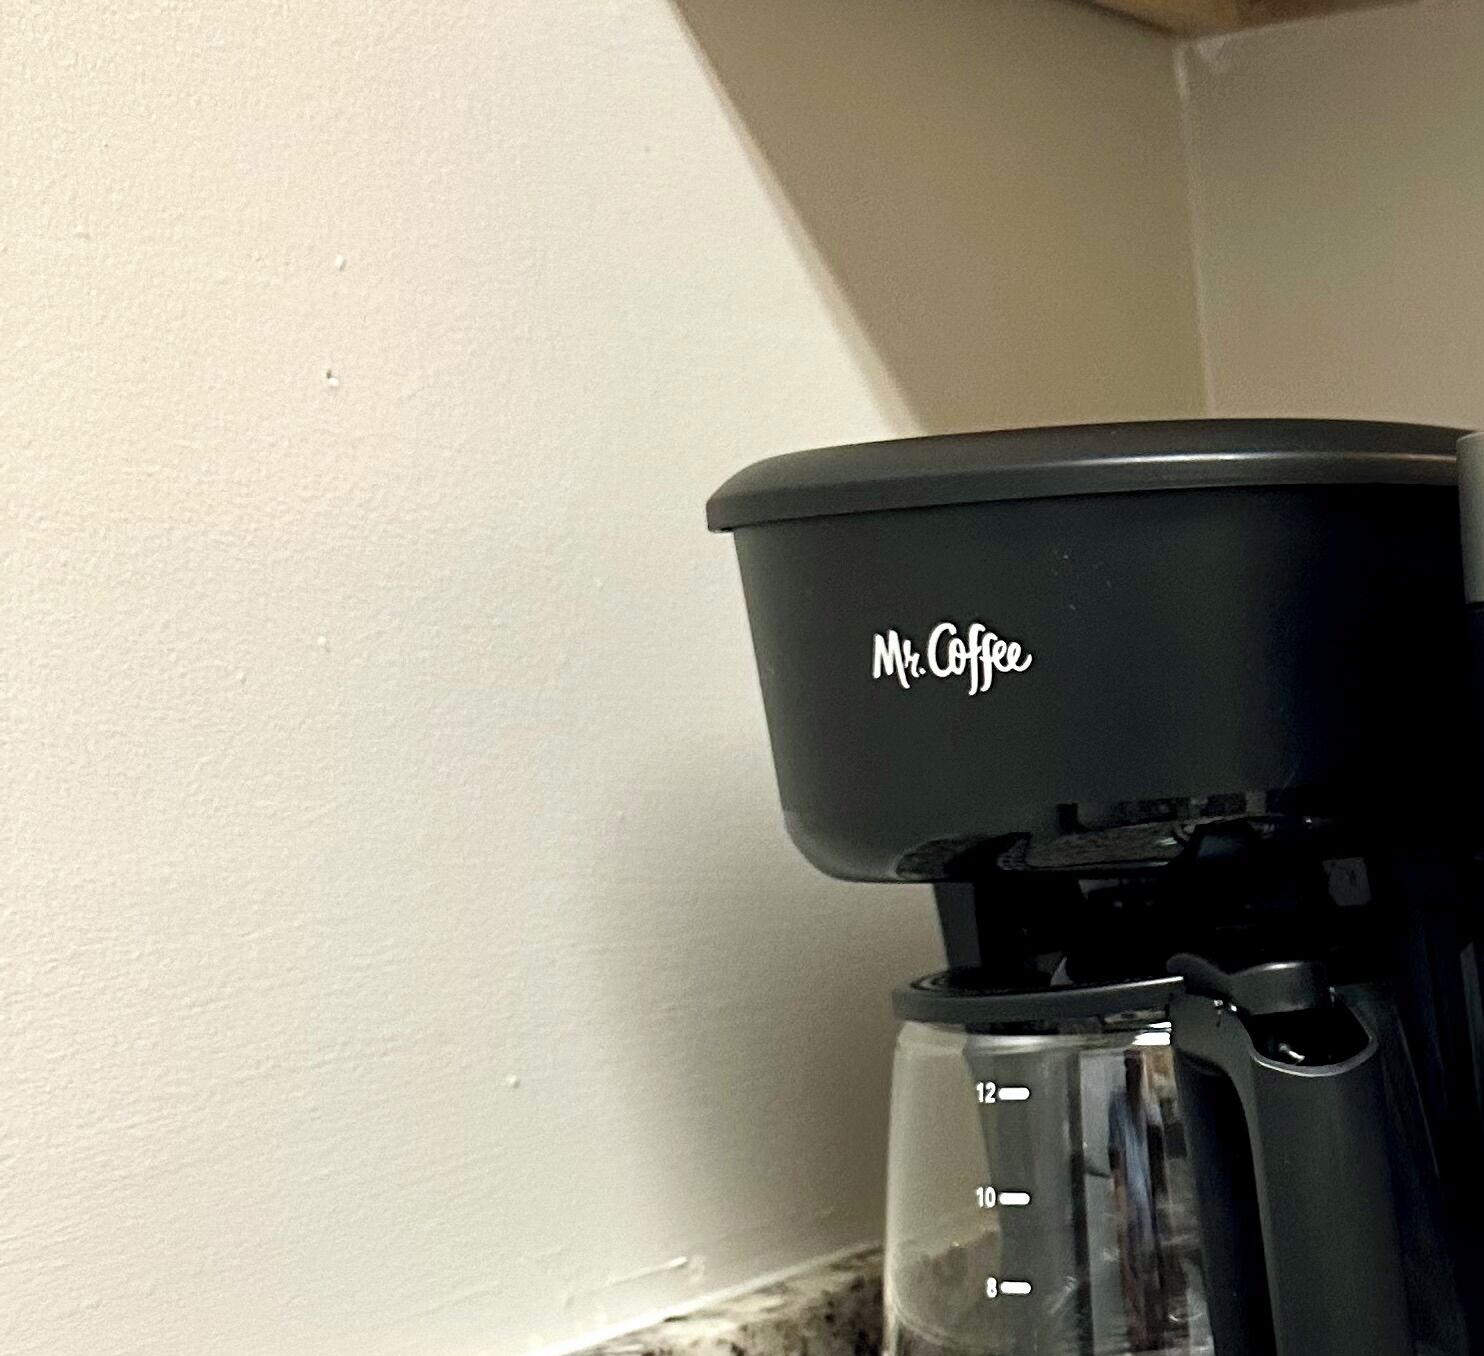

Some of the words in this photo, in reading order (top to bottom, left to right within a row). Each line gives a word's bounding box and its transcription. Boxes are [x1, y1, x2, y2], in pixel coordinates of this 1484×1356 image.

[872, 629, 926, 689] Mr.
[927, 622, 1033, 696] Coffee
[976, 1081, 997, 1104] 12
[976, 1187, 997, 1208] 10
[986, 1278, 998, 1298] 8
